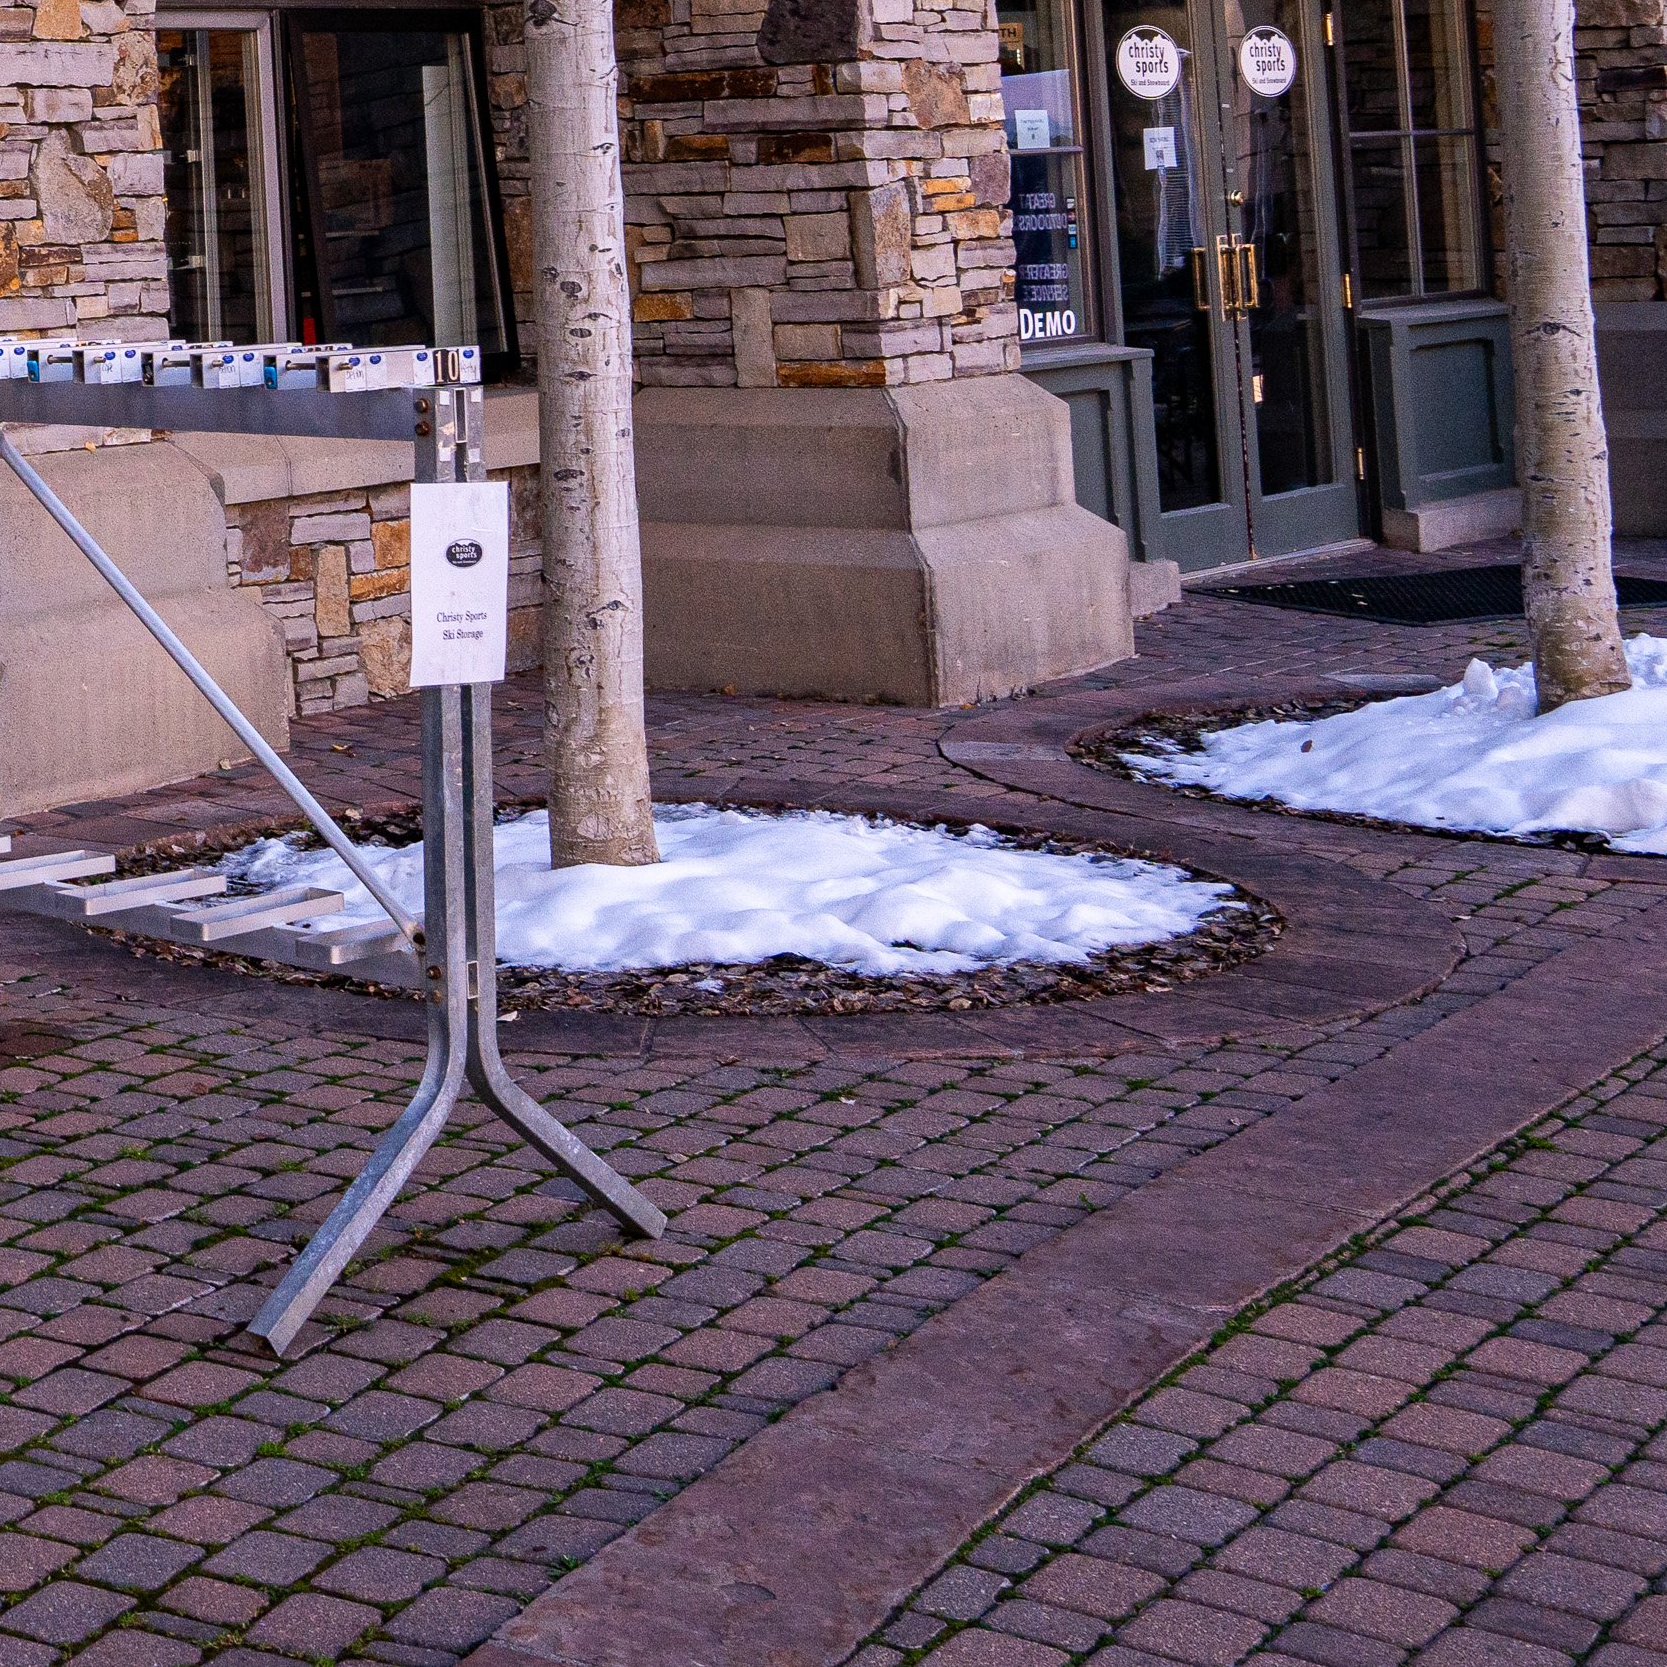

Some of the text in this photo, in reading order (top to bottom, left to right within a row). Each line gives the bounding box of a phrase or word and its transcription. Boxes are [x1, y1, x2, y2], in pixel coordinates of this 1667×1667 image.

[1128, 42, 1165, 60] christy
[1249, 42, 1282, 59] christy
[1135, 59, 1169, 77] sports
[1255, 58, 1286, 75] sports
[1019, 308, 1076, 340] DEMO
[435, 350, 459, 383] 10
[456, 552, 477, 560] sports
[437, 611, 487, 623] Christy Sports
[443, 629, 483, 640] Ski Storage
